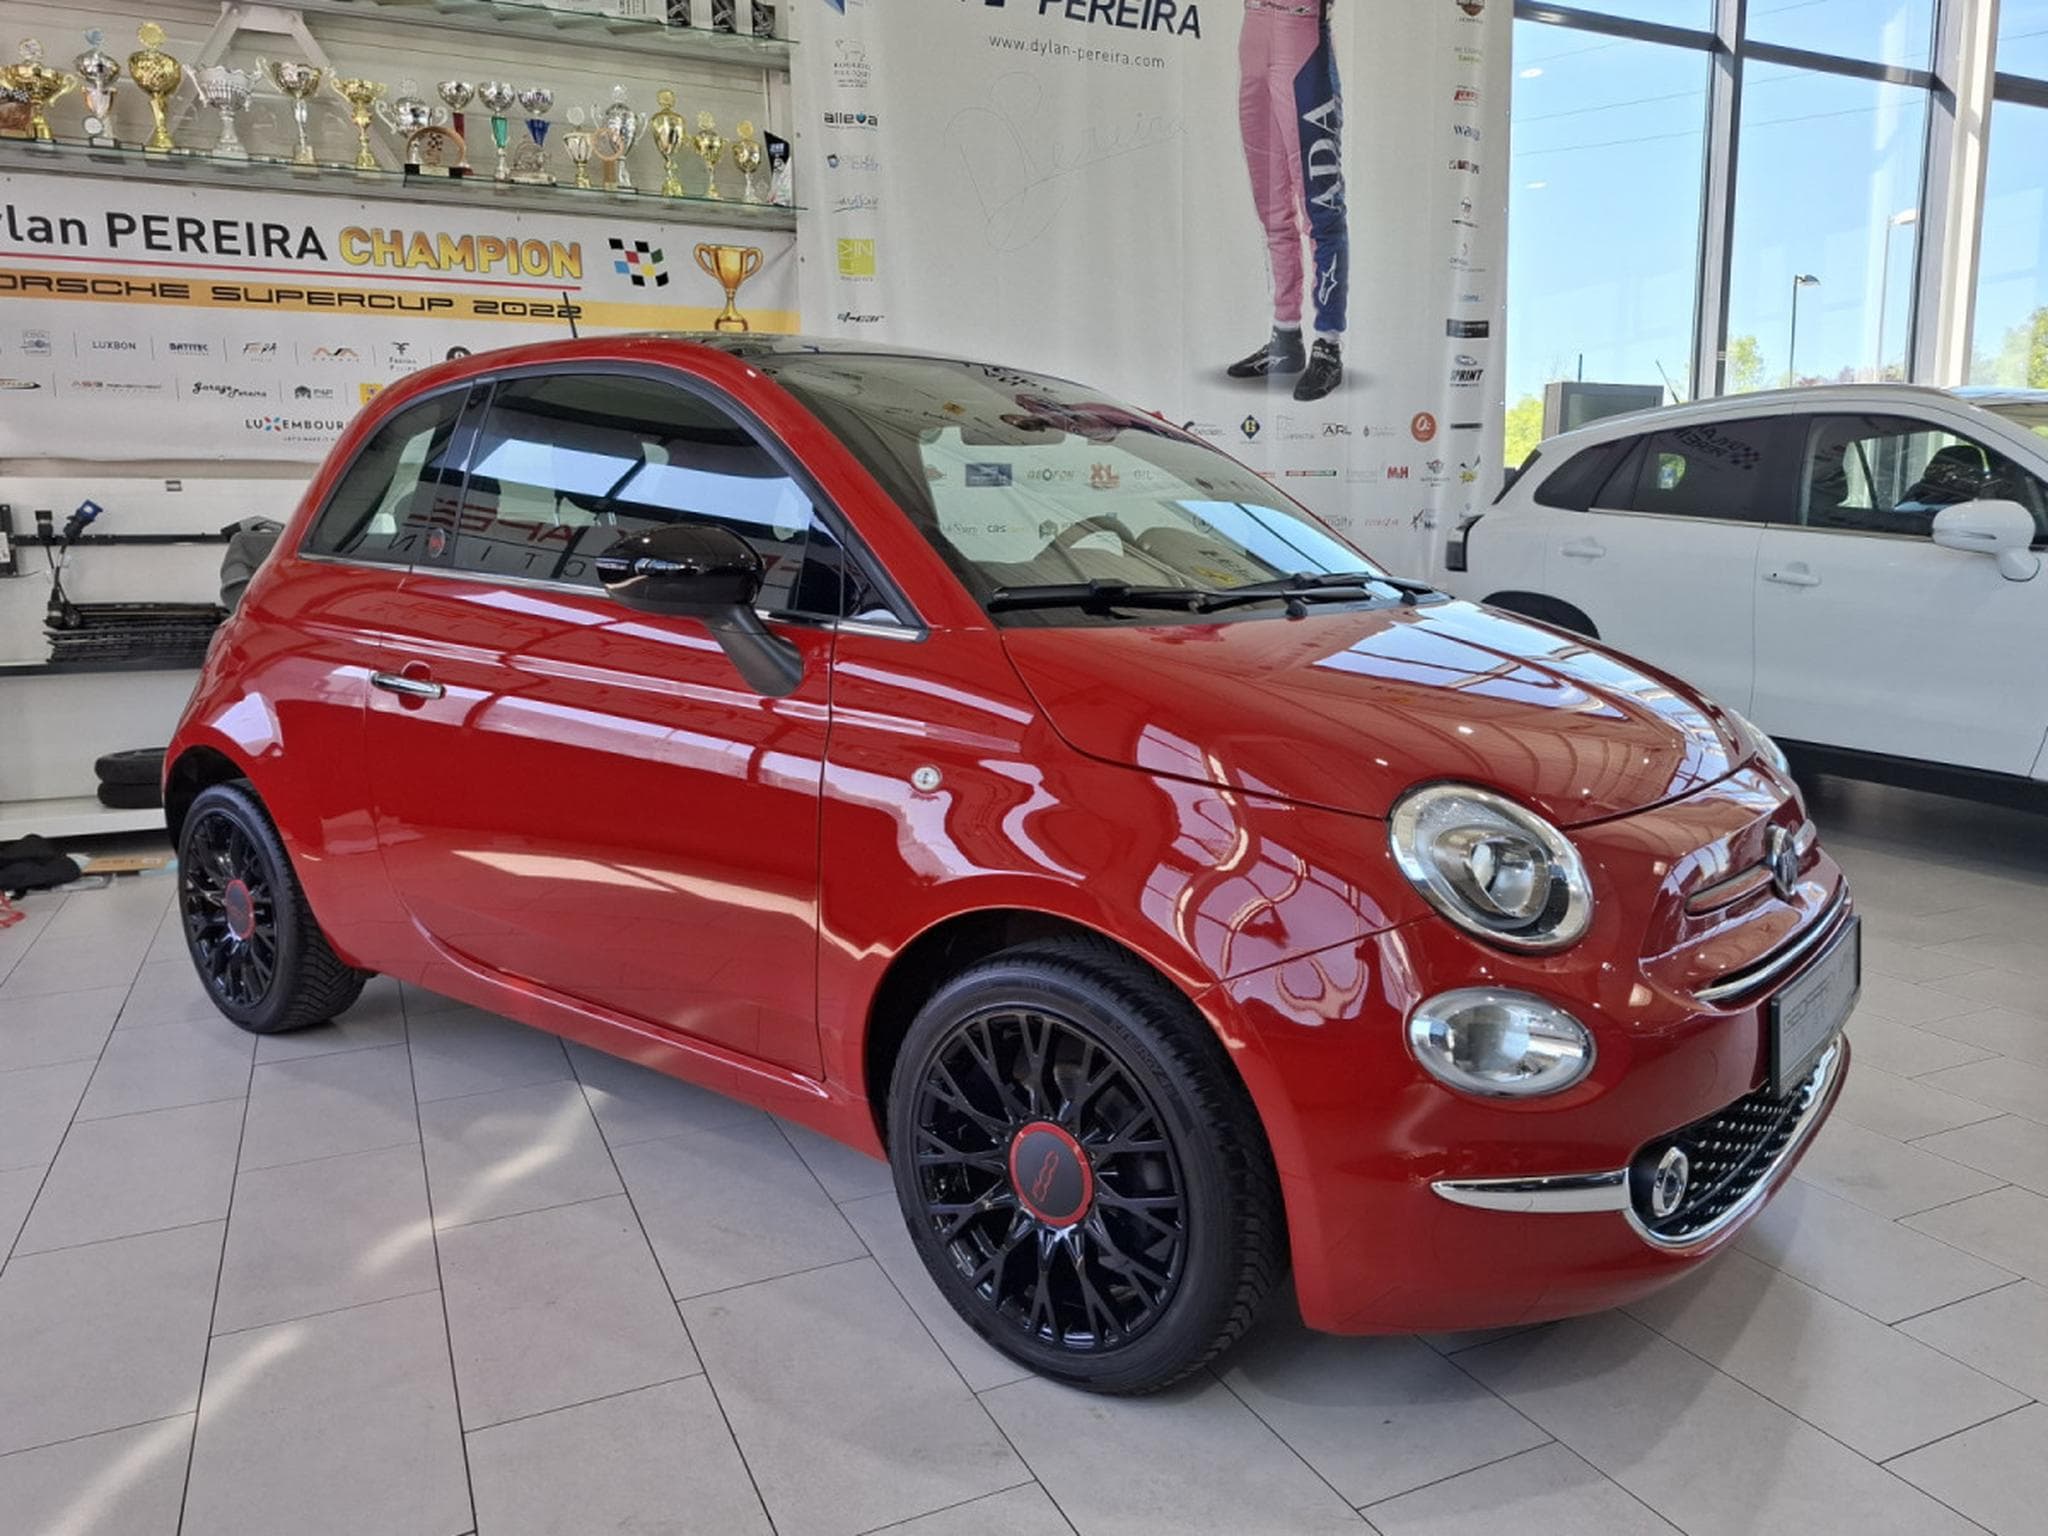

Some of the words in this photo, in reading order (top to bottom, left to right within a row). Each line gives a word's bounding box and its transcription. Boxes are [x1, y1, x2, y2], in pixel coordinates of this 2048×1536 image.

[989, 35, 1166, 68] www.dylan-pereira.com
[0, 204, 88, 246] lan
[106, 212, 328, 261] PEREIRA
[339, 225, 583, 280] CHAMPION
[211, 286, 454, 312] SUPERCUP
[472, 300, 582, 319] 2022
